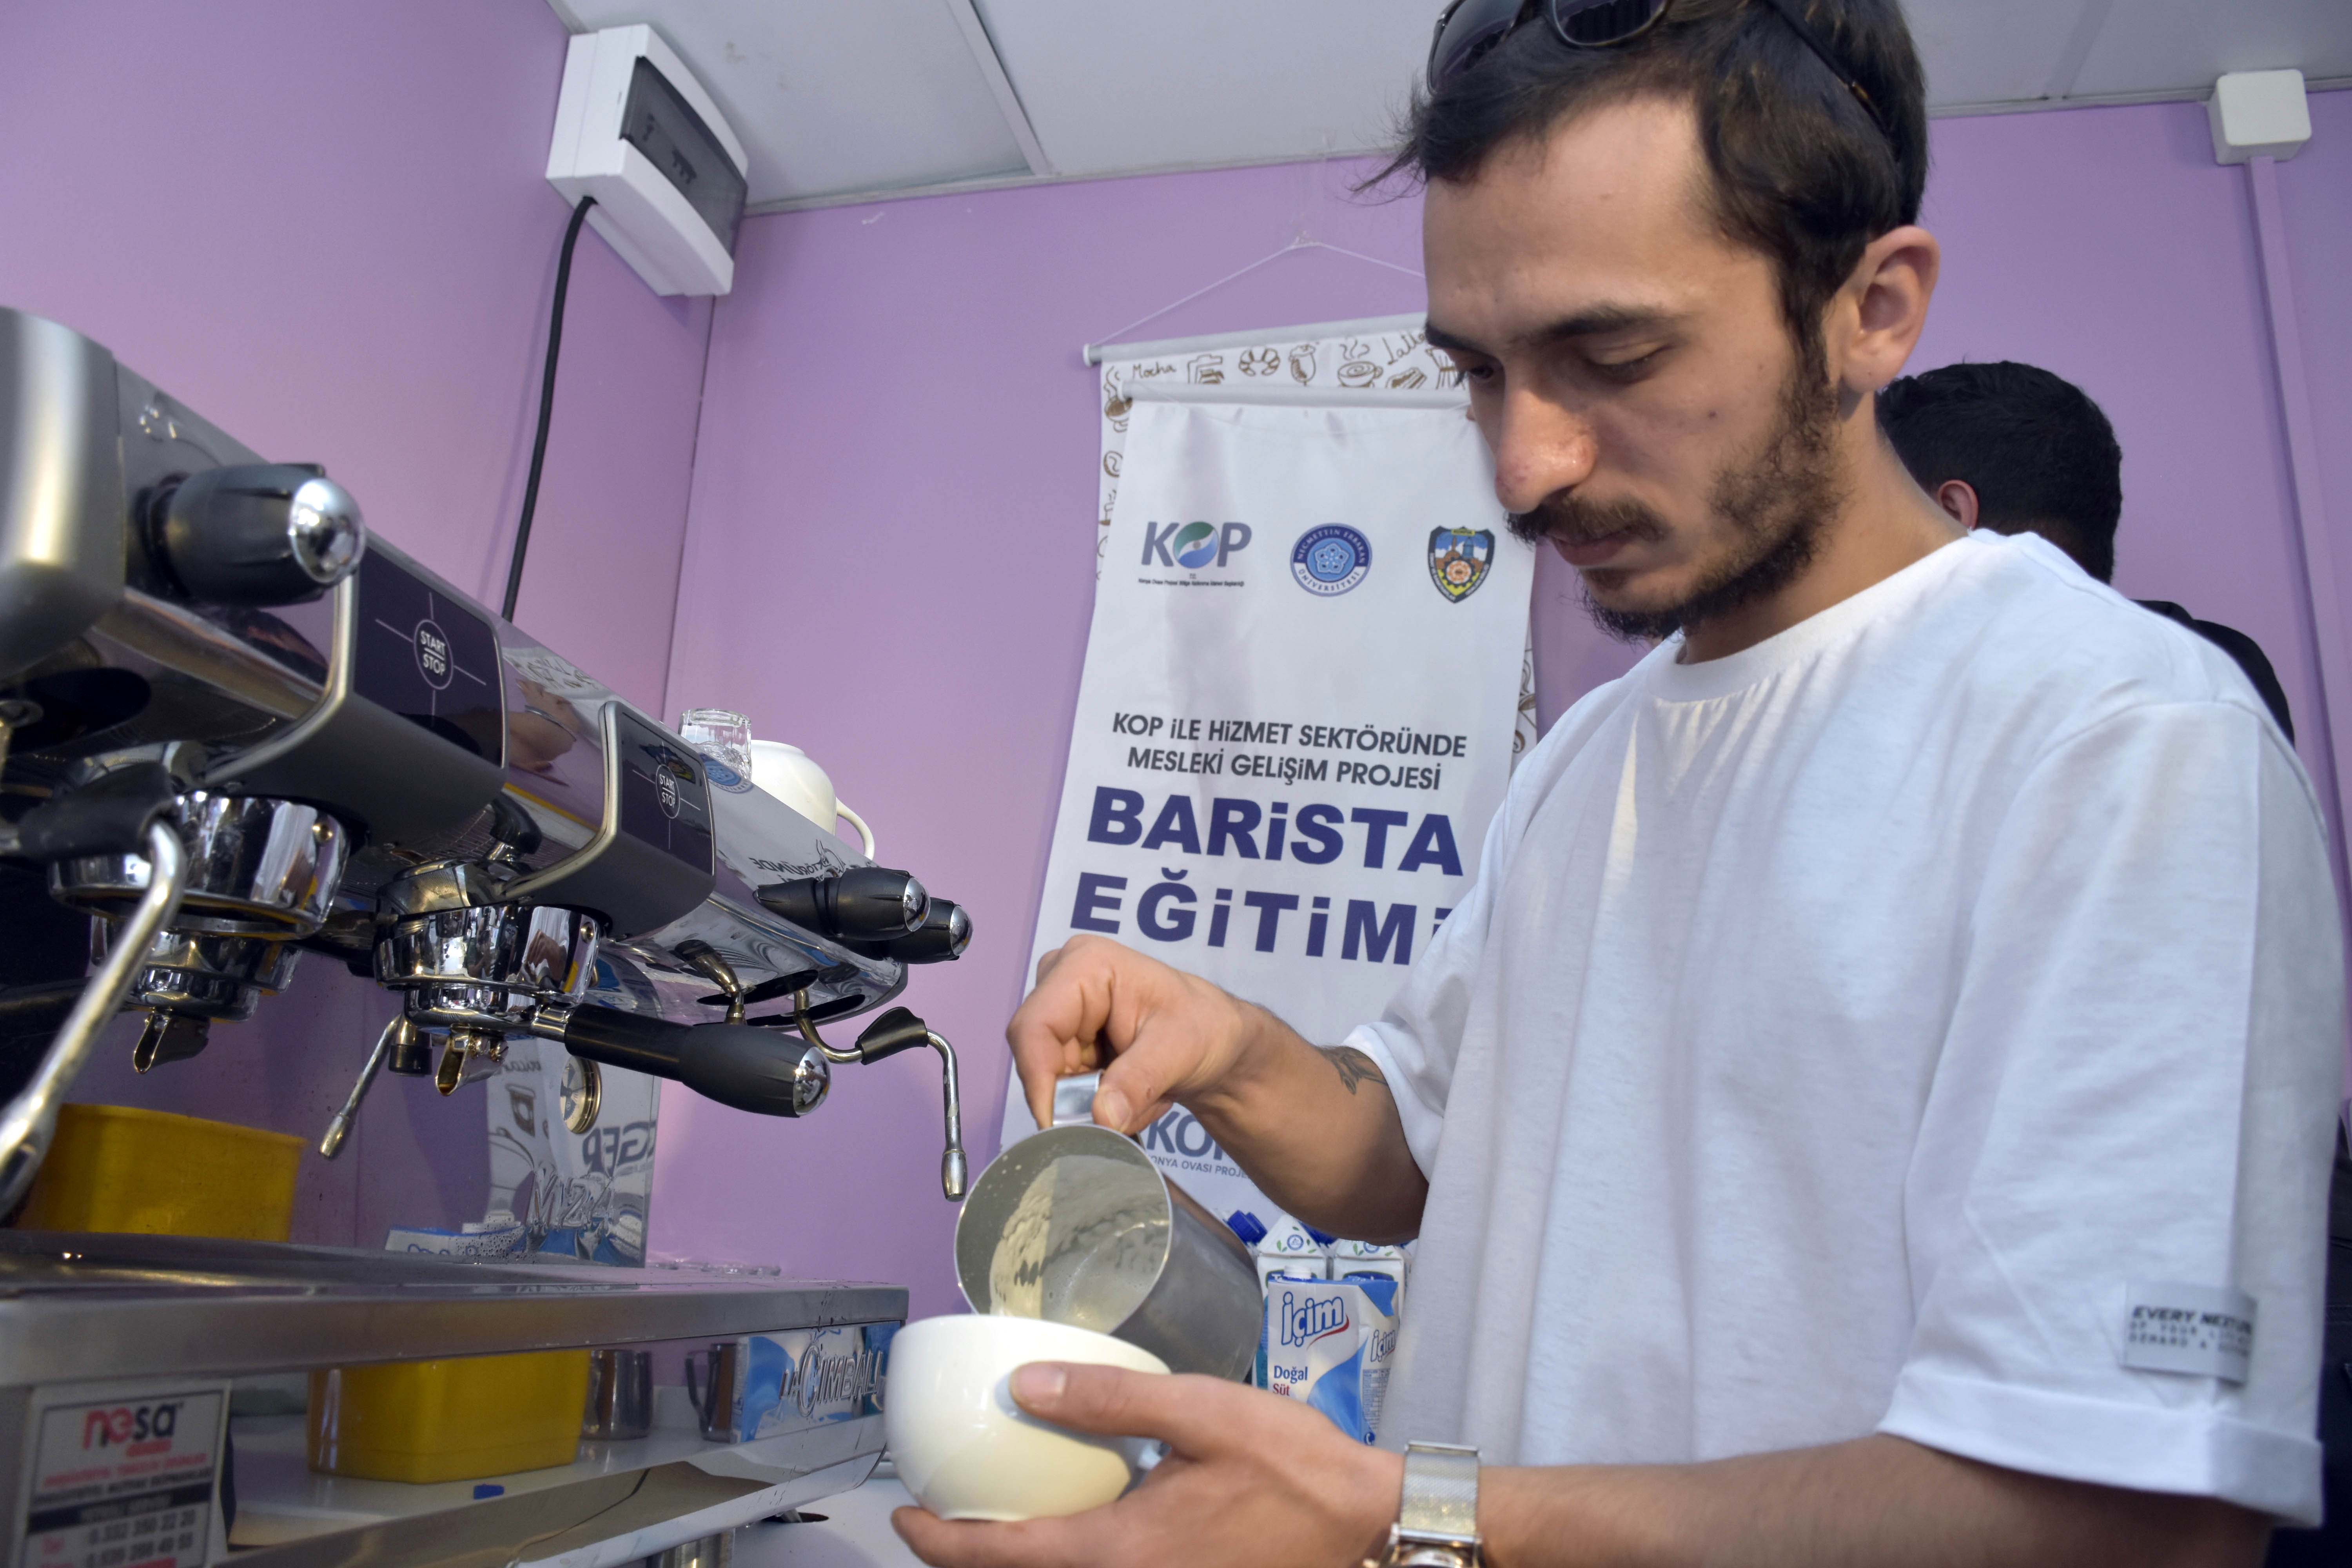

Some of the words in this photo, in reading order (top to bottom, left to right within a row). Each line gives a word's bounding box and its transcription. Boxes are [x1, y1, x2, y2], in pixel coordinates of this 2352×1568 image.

[1132, 360, 1176, 380] Mocha
[421, 630, 445, 656] START
[423, 653, 445, 676] STOP
[1112, 712, 1163, 737] KOP
[1299, 724, 1467, 757] SEKTÖRÜNDE
[1127, 747, 1224, 775] MESLEKİ
[1336, 760, 1442, 790] PROJESİ
[659, 773, 675, 791] START
[662, 791, 675, 808] STOP
[1181, 1161, 1212, 1173] OVASI
[1281, 1291, 1344, 1347] İçim
[2132, 1305, 2196, 1322] EVERY
[1370, 1329, 1396, 1362] İçim
[779, 1367, 800, 1400] LA
[798, 1343, 883, 1417] CIMBALI
[1274, 1365, 1308, 1384] Doğal
[1273, 1383, 1290, 1396] Süt
